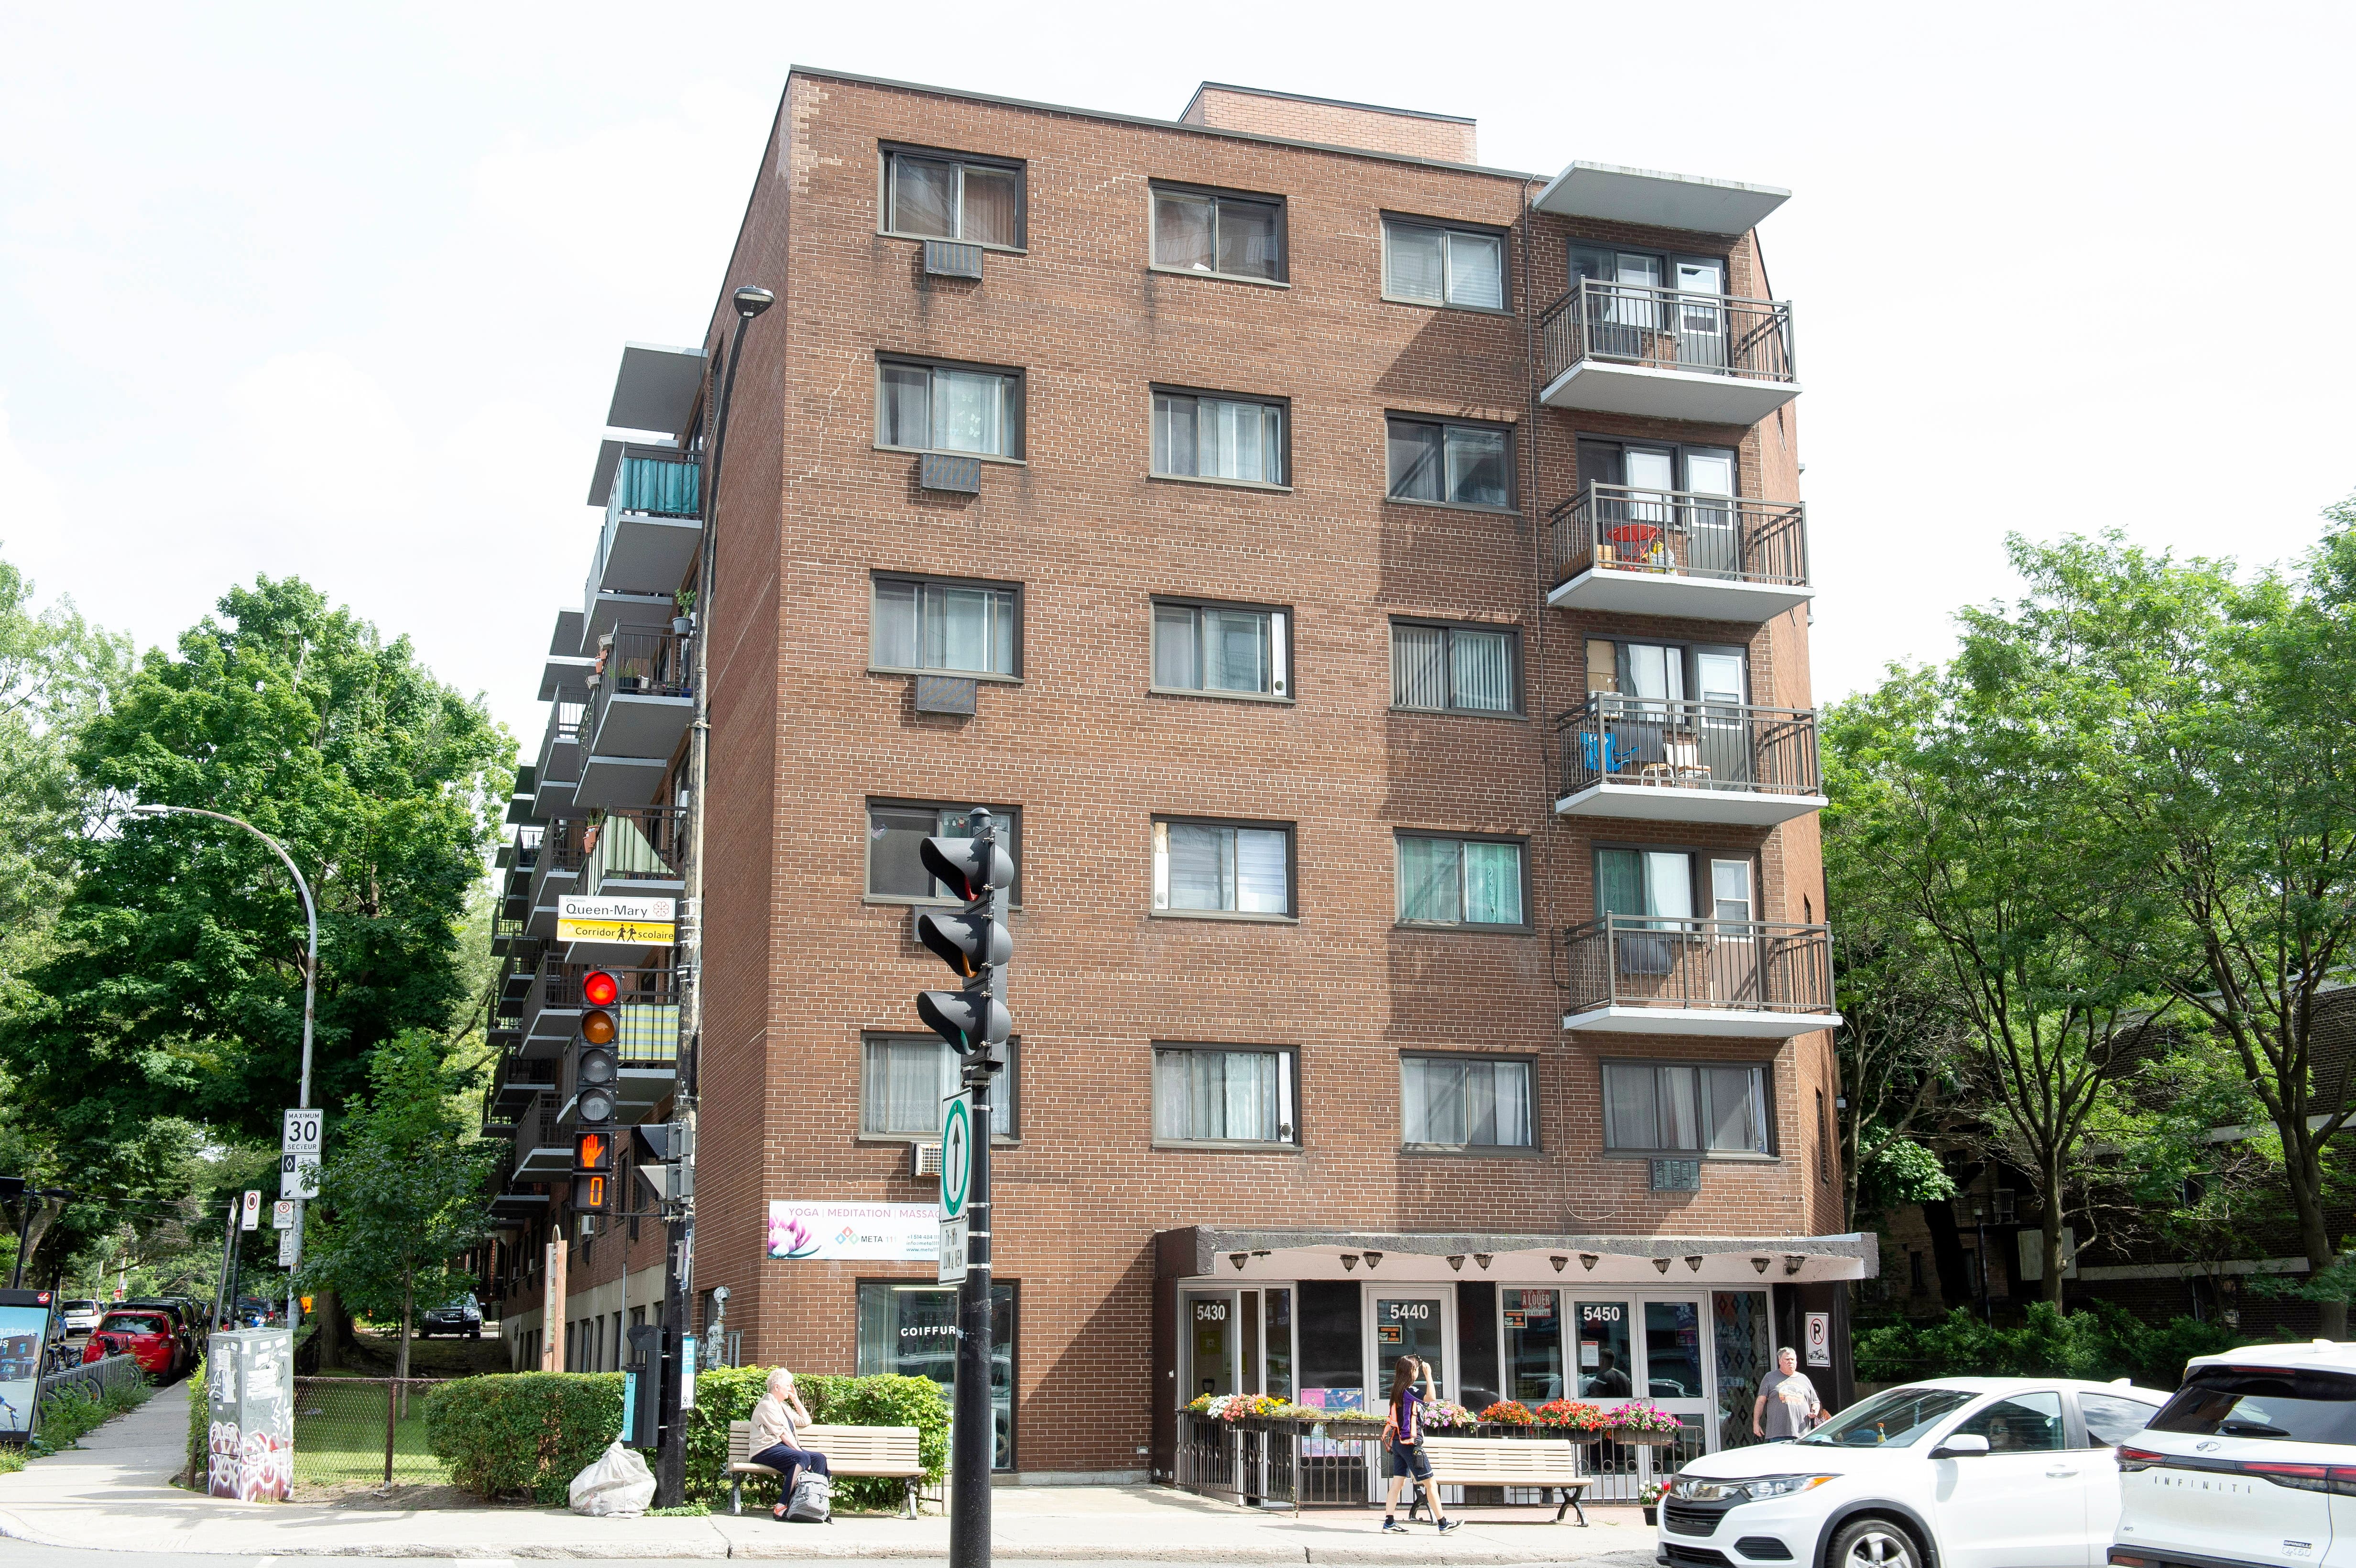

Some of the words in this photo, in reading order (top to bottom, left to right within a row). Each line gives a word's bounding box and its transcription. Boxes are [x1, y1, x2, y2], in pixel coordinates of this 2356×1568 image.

[566, 904, 648, 918] Queen-Mary
[575, 927, 615, 936] Corridor
[638, 931, 674, 939] scolaire
[288, 1121, 317, 1142] 30
[589, 1177, 603, 1206] 0
[789, 1208, 819, 1217] YOGA
[828, 1209, 891, 1218] MEDITATION
[1528, 1294, 1550, 1306] LOUER
[1197, 1305, 1225, 1320] 5430
[1390, 1304, 1429, 1319] 5440
[1583, 1307, 1620, 1321] 5450
[2154, 1476, 2251, 1494] INFINITI
[2281, 1546, 2311, 1557] QX60
